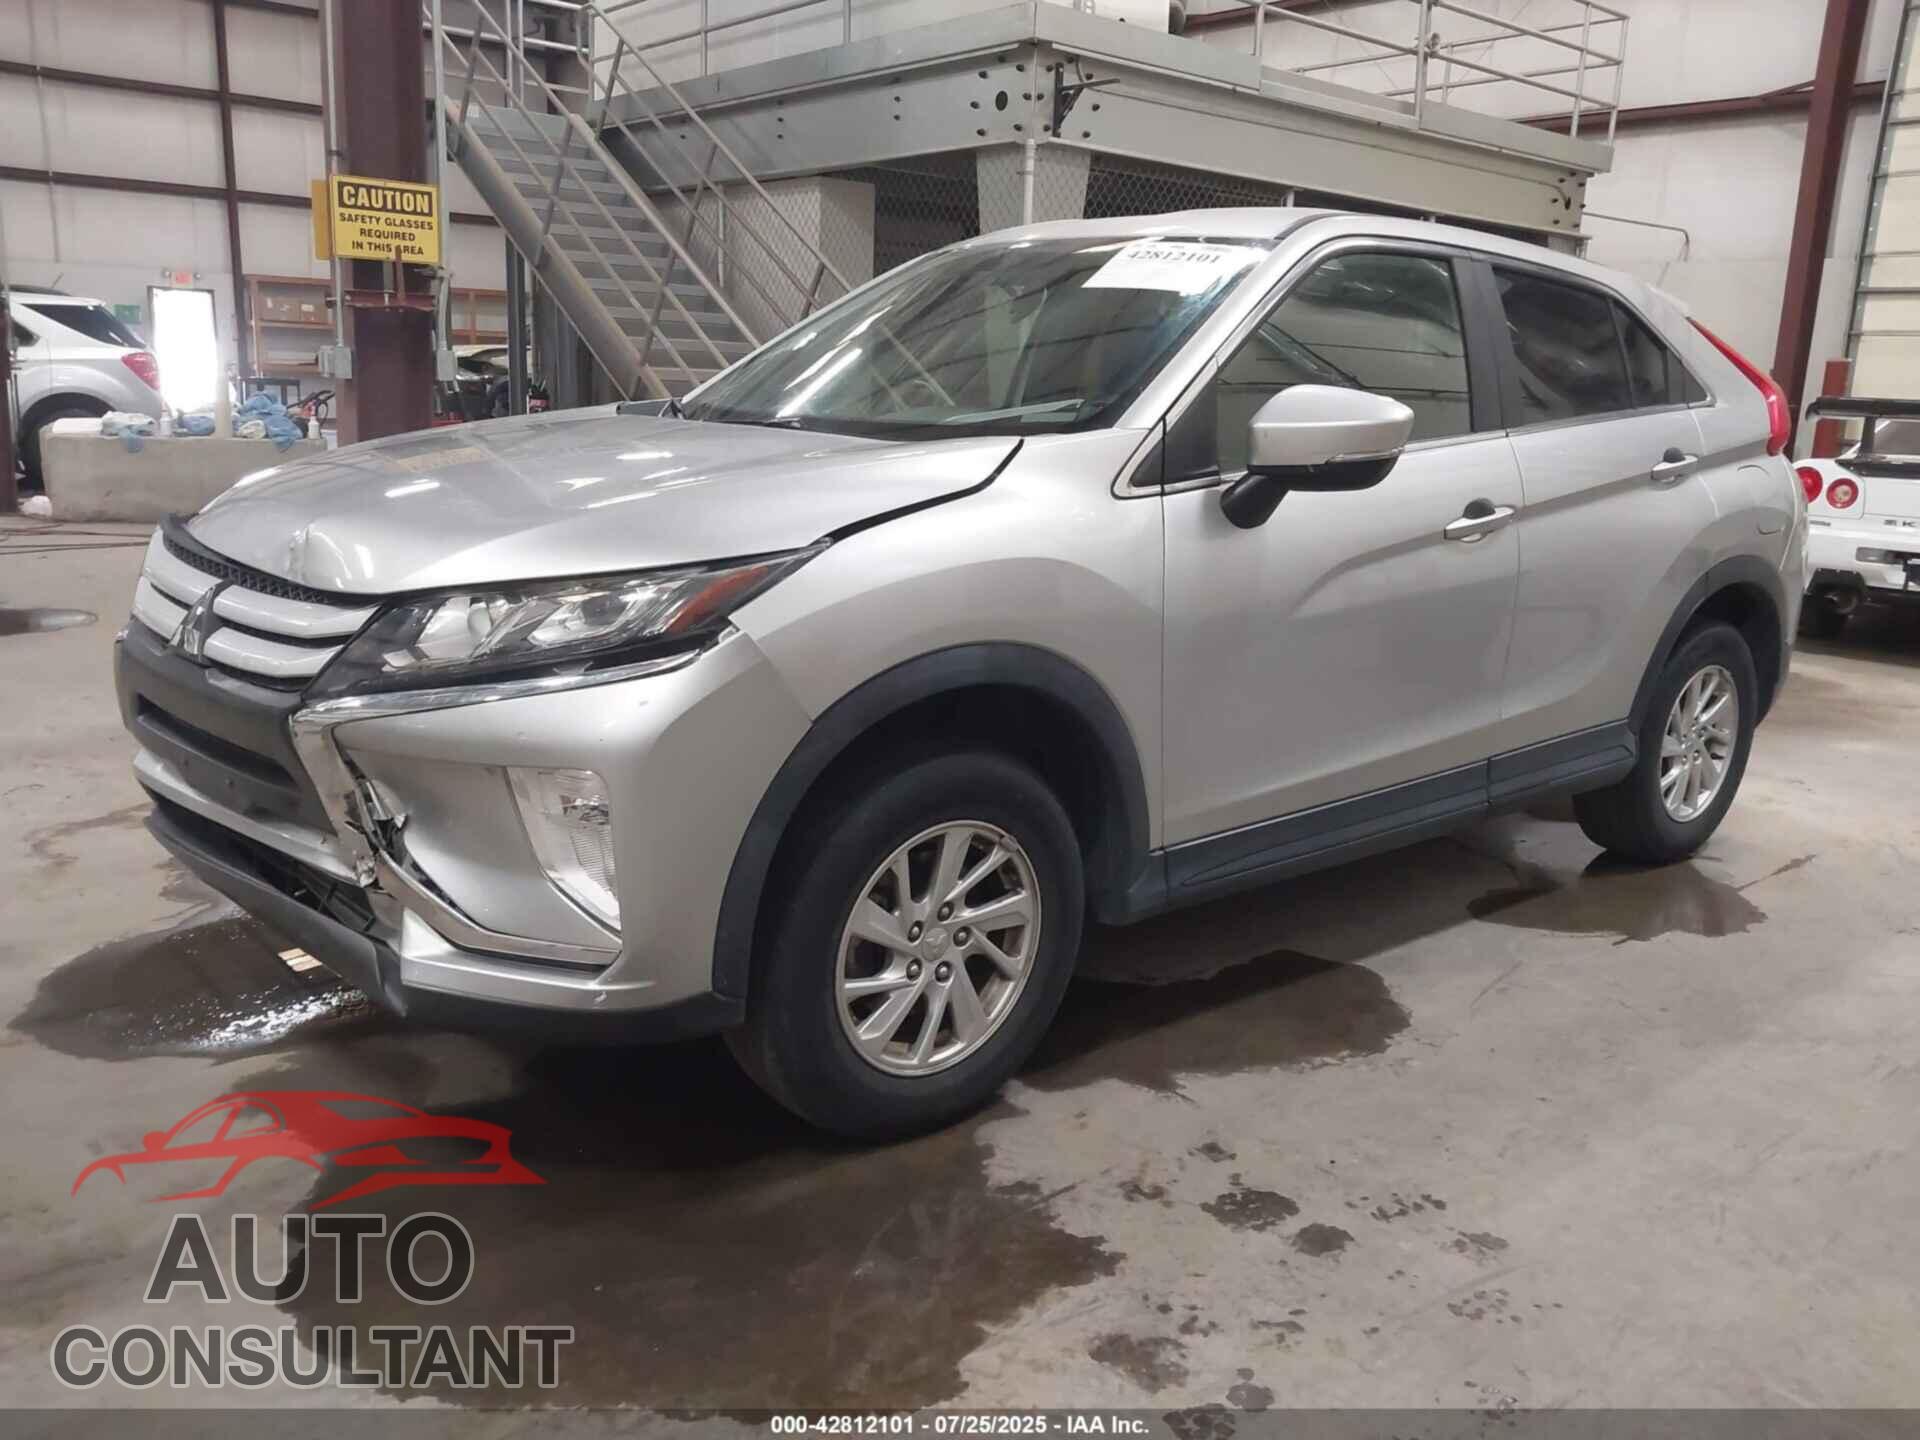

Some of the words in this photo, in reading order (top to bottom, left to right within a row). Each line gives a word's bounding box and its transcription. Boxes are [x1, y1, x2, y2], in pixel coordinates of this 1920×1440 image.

[342, 186, 429, 213] CAUTION
[340, 213, 380, 225] SAFETY
[385, 218, 433, 230] GLASSES
[360, 228, 415, 241] REQUIRED
[352, 240, 364, 250] IN
[367, 241, 392, 252] THIS
[1128, 250, 1220, 263] 42812101
